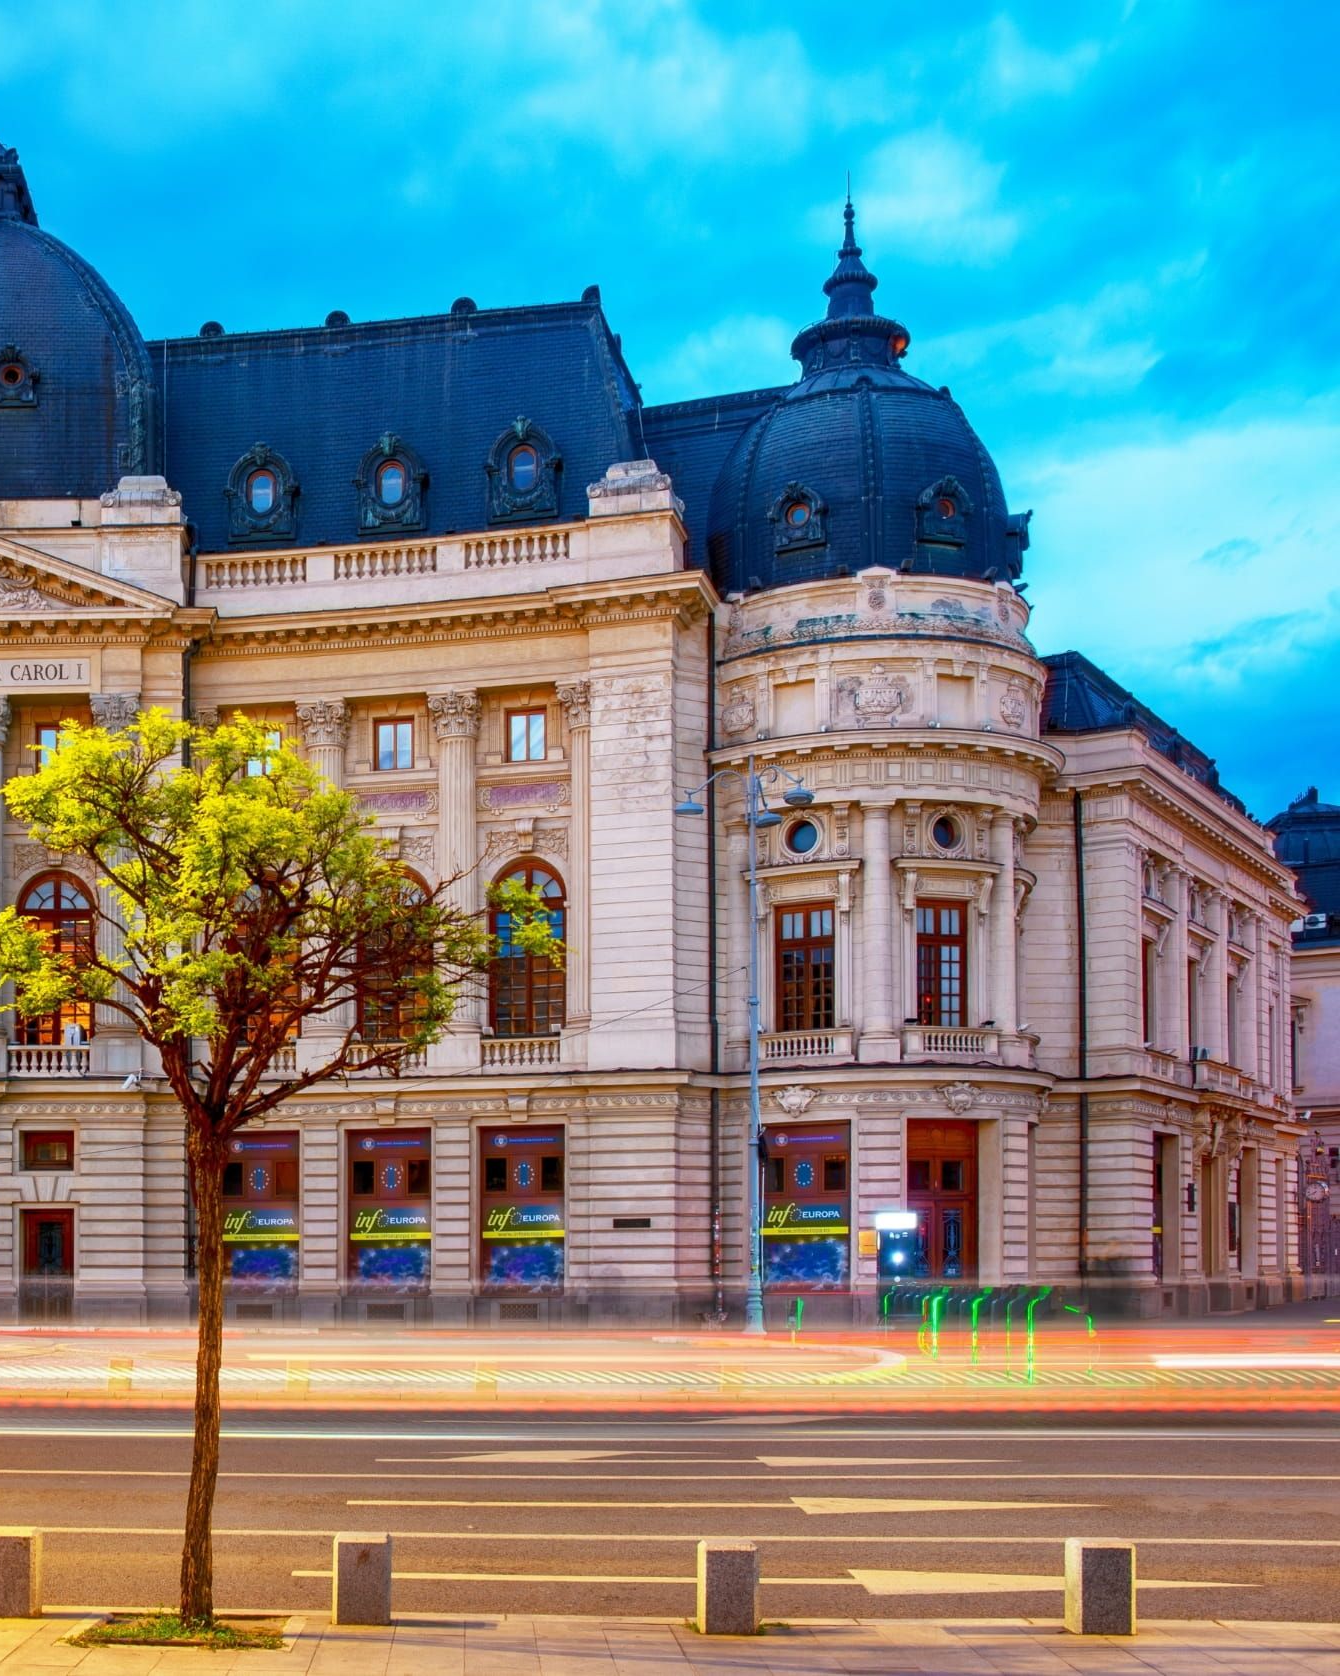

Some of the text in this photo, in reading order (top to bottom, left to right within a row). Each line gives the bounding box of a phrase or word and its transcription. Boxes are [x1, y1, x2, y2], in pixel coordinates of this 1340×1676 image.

[10, 663, 69, 681] CAROL
[76, 663, 83, 680] I
[522, 1213, 560, 1222] EUROPA
[802, 1210, 840, 1219] EUROPA
[258, 1218, 294, 1226] EUROPA
[389, 1216, 427, 1225] EUROPA
